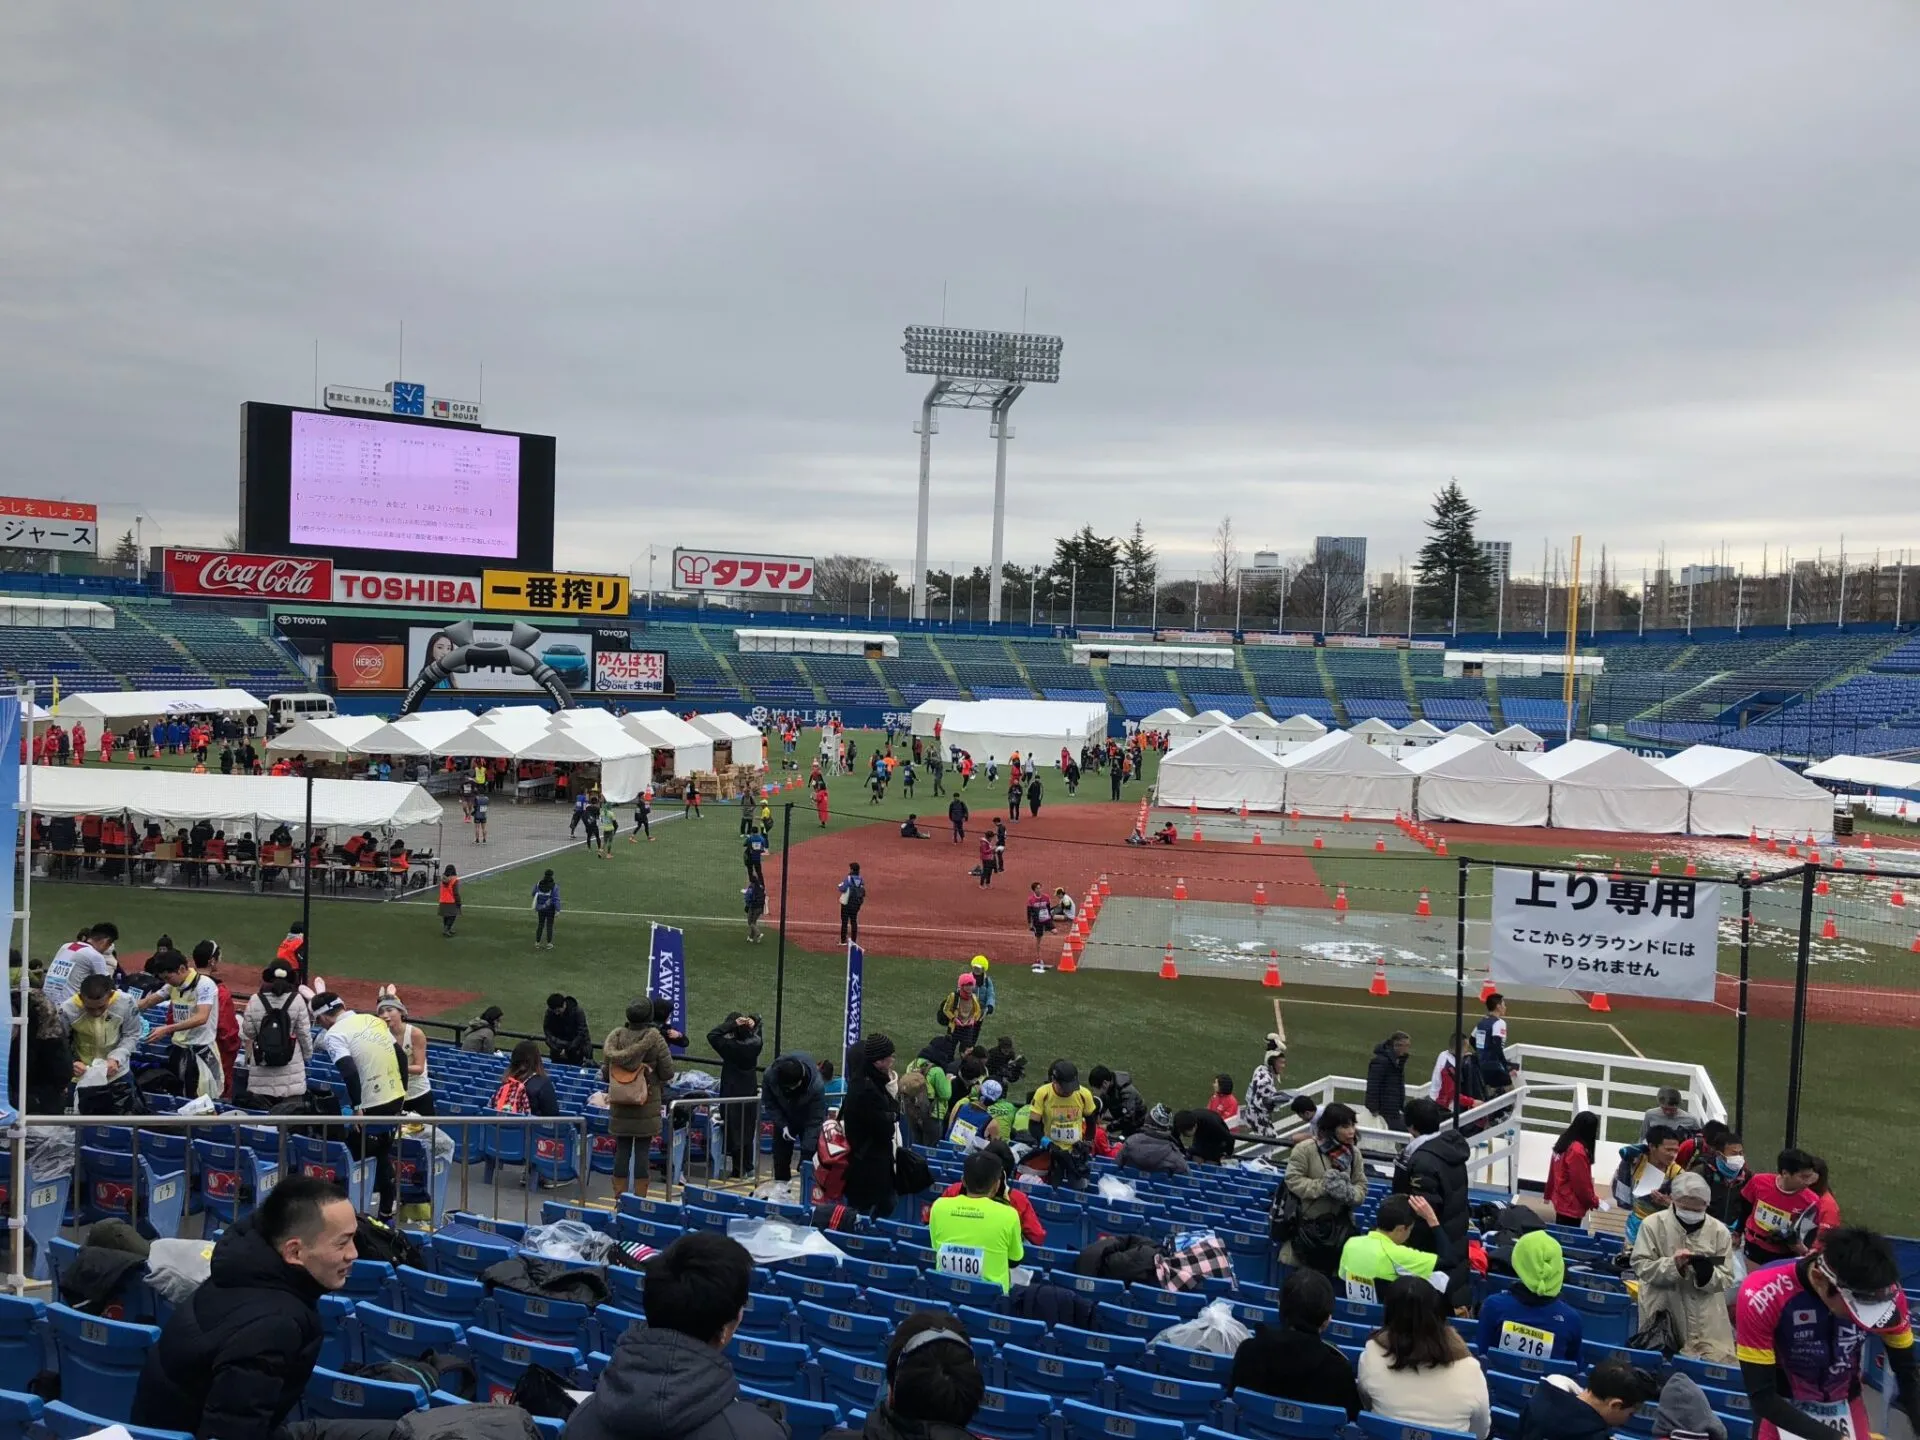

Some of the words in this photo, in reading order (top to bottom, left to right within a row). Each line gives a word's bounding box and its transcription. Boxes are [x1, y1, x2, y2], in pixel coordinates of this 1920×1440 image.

[452, 403, 479, 413] OPEN
[452, 413, 478, 421] HOUSE
[5, 520, 91, 545] ジャース
[175, 552, 201, 563] Enjoy
[199, 555, 319, 595] Coca-Cola
[711, 559, 813, 590] タフマン
[339, 574, 477, 604] TOSHIBA
[491, 577, 621, 611] 一番搾り
[292, 617, 327, 626] TOYOTA
[598, 629, 629, 638] TOYOTA
[597, 652, 663, 668] がんばれ!
[607, 666, 663, 680] スワローズ!
[401, 679, 426, 713] UNDER
[1514, 870, 1697, 920] 上り専用
[1512, 927, 1696, 958] ここからグラウンドには
[1543, 953, 1660, 978] 下りられません
[672, 961, 681, 1023] INTERMODE
[848, 972, 861, 1046] KAWAB
[941, 1255, 947, 1269] C
[951, 1255, 980, 1275] 1180
[1503, 1333, 1511, 1347] C
[1518, 1336, 1544, 1357] 216
